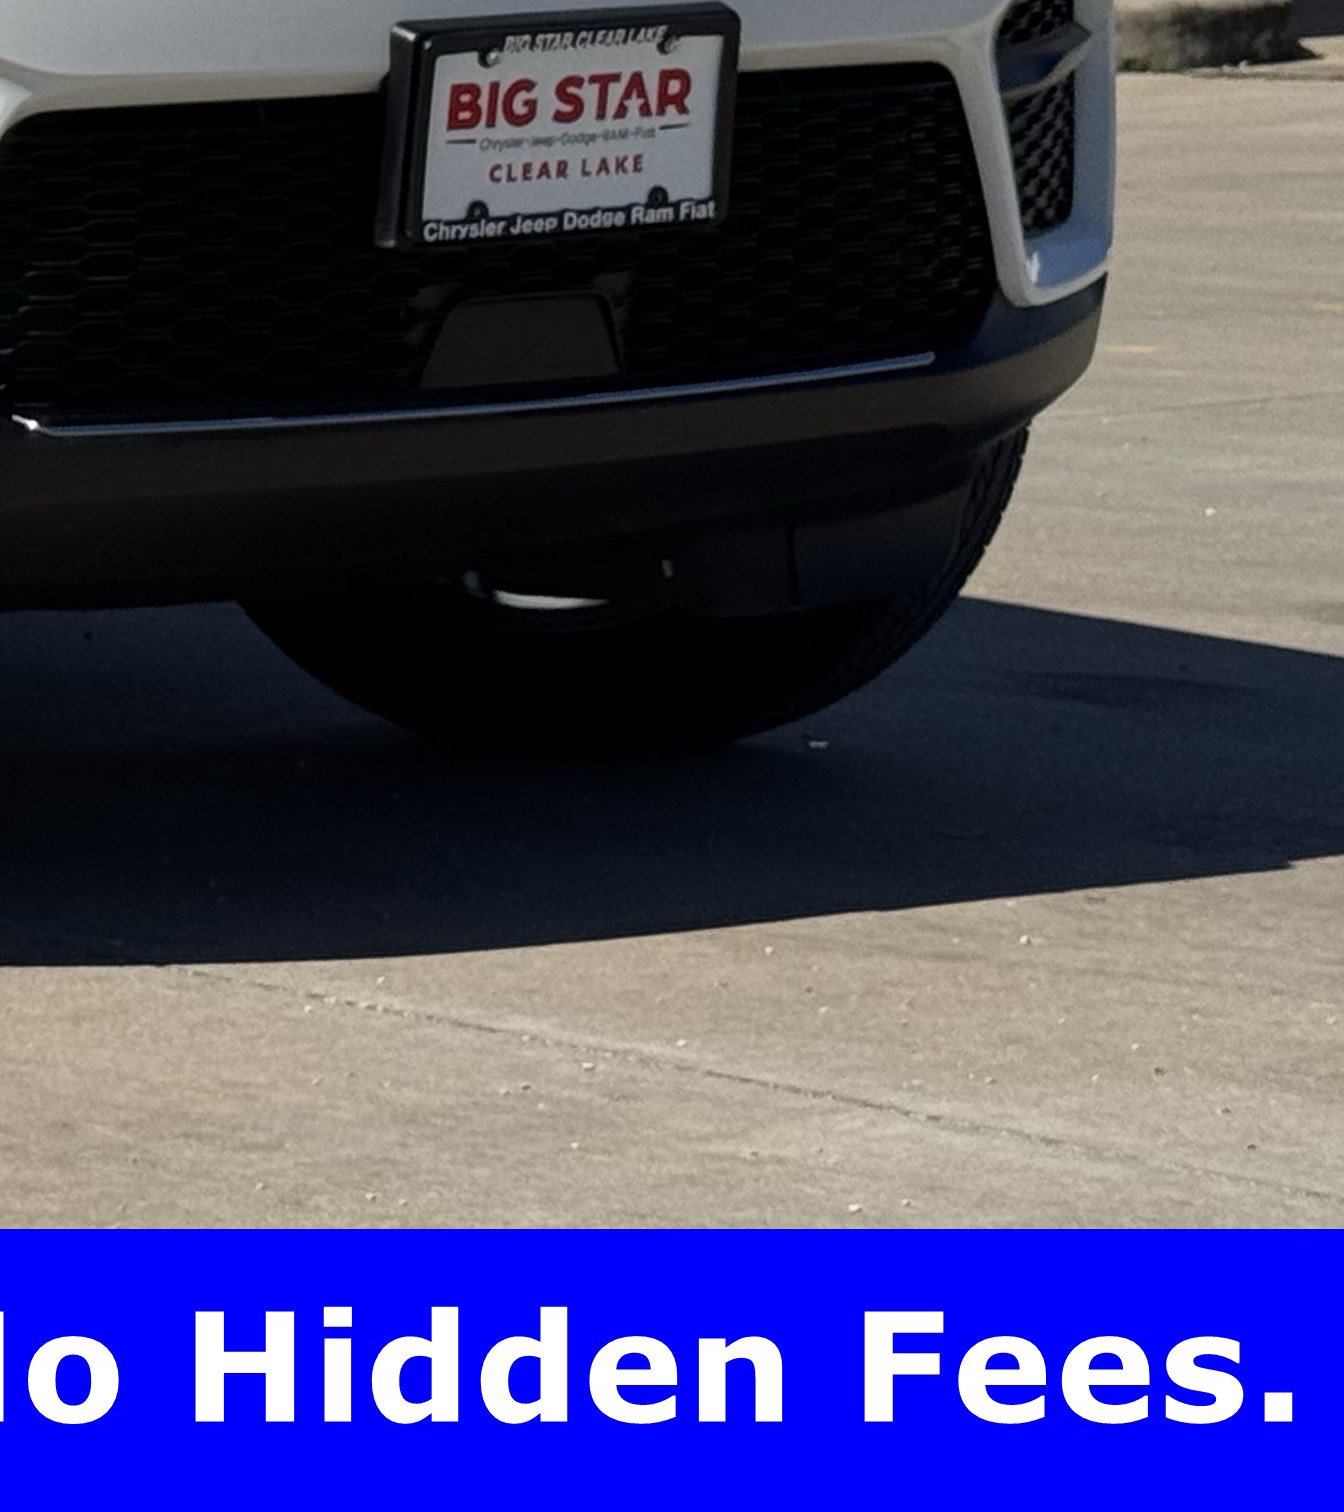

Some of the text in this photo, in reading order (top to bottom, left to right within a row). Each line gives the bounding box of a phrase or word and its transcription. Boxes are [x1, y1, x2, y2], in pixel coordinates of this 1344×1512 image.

[502, 25, 670, 53] BIG STAR CLEAR LAKE
[446, 68, 693, 132] BIG STAR
[488, 153, 644, 184] CLEAR LAKE
[423, 199, 716, 243] Chrysler Jeep Dodge Ram Fiat
